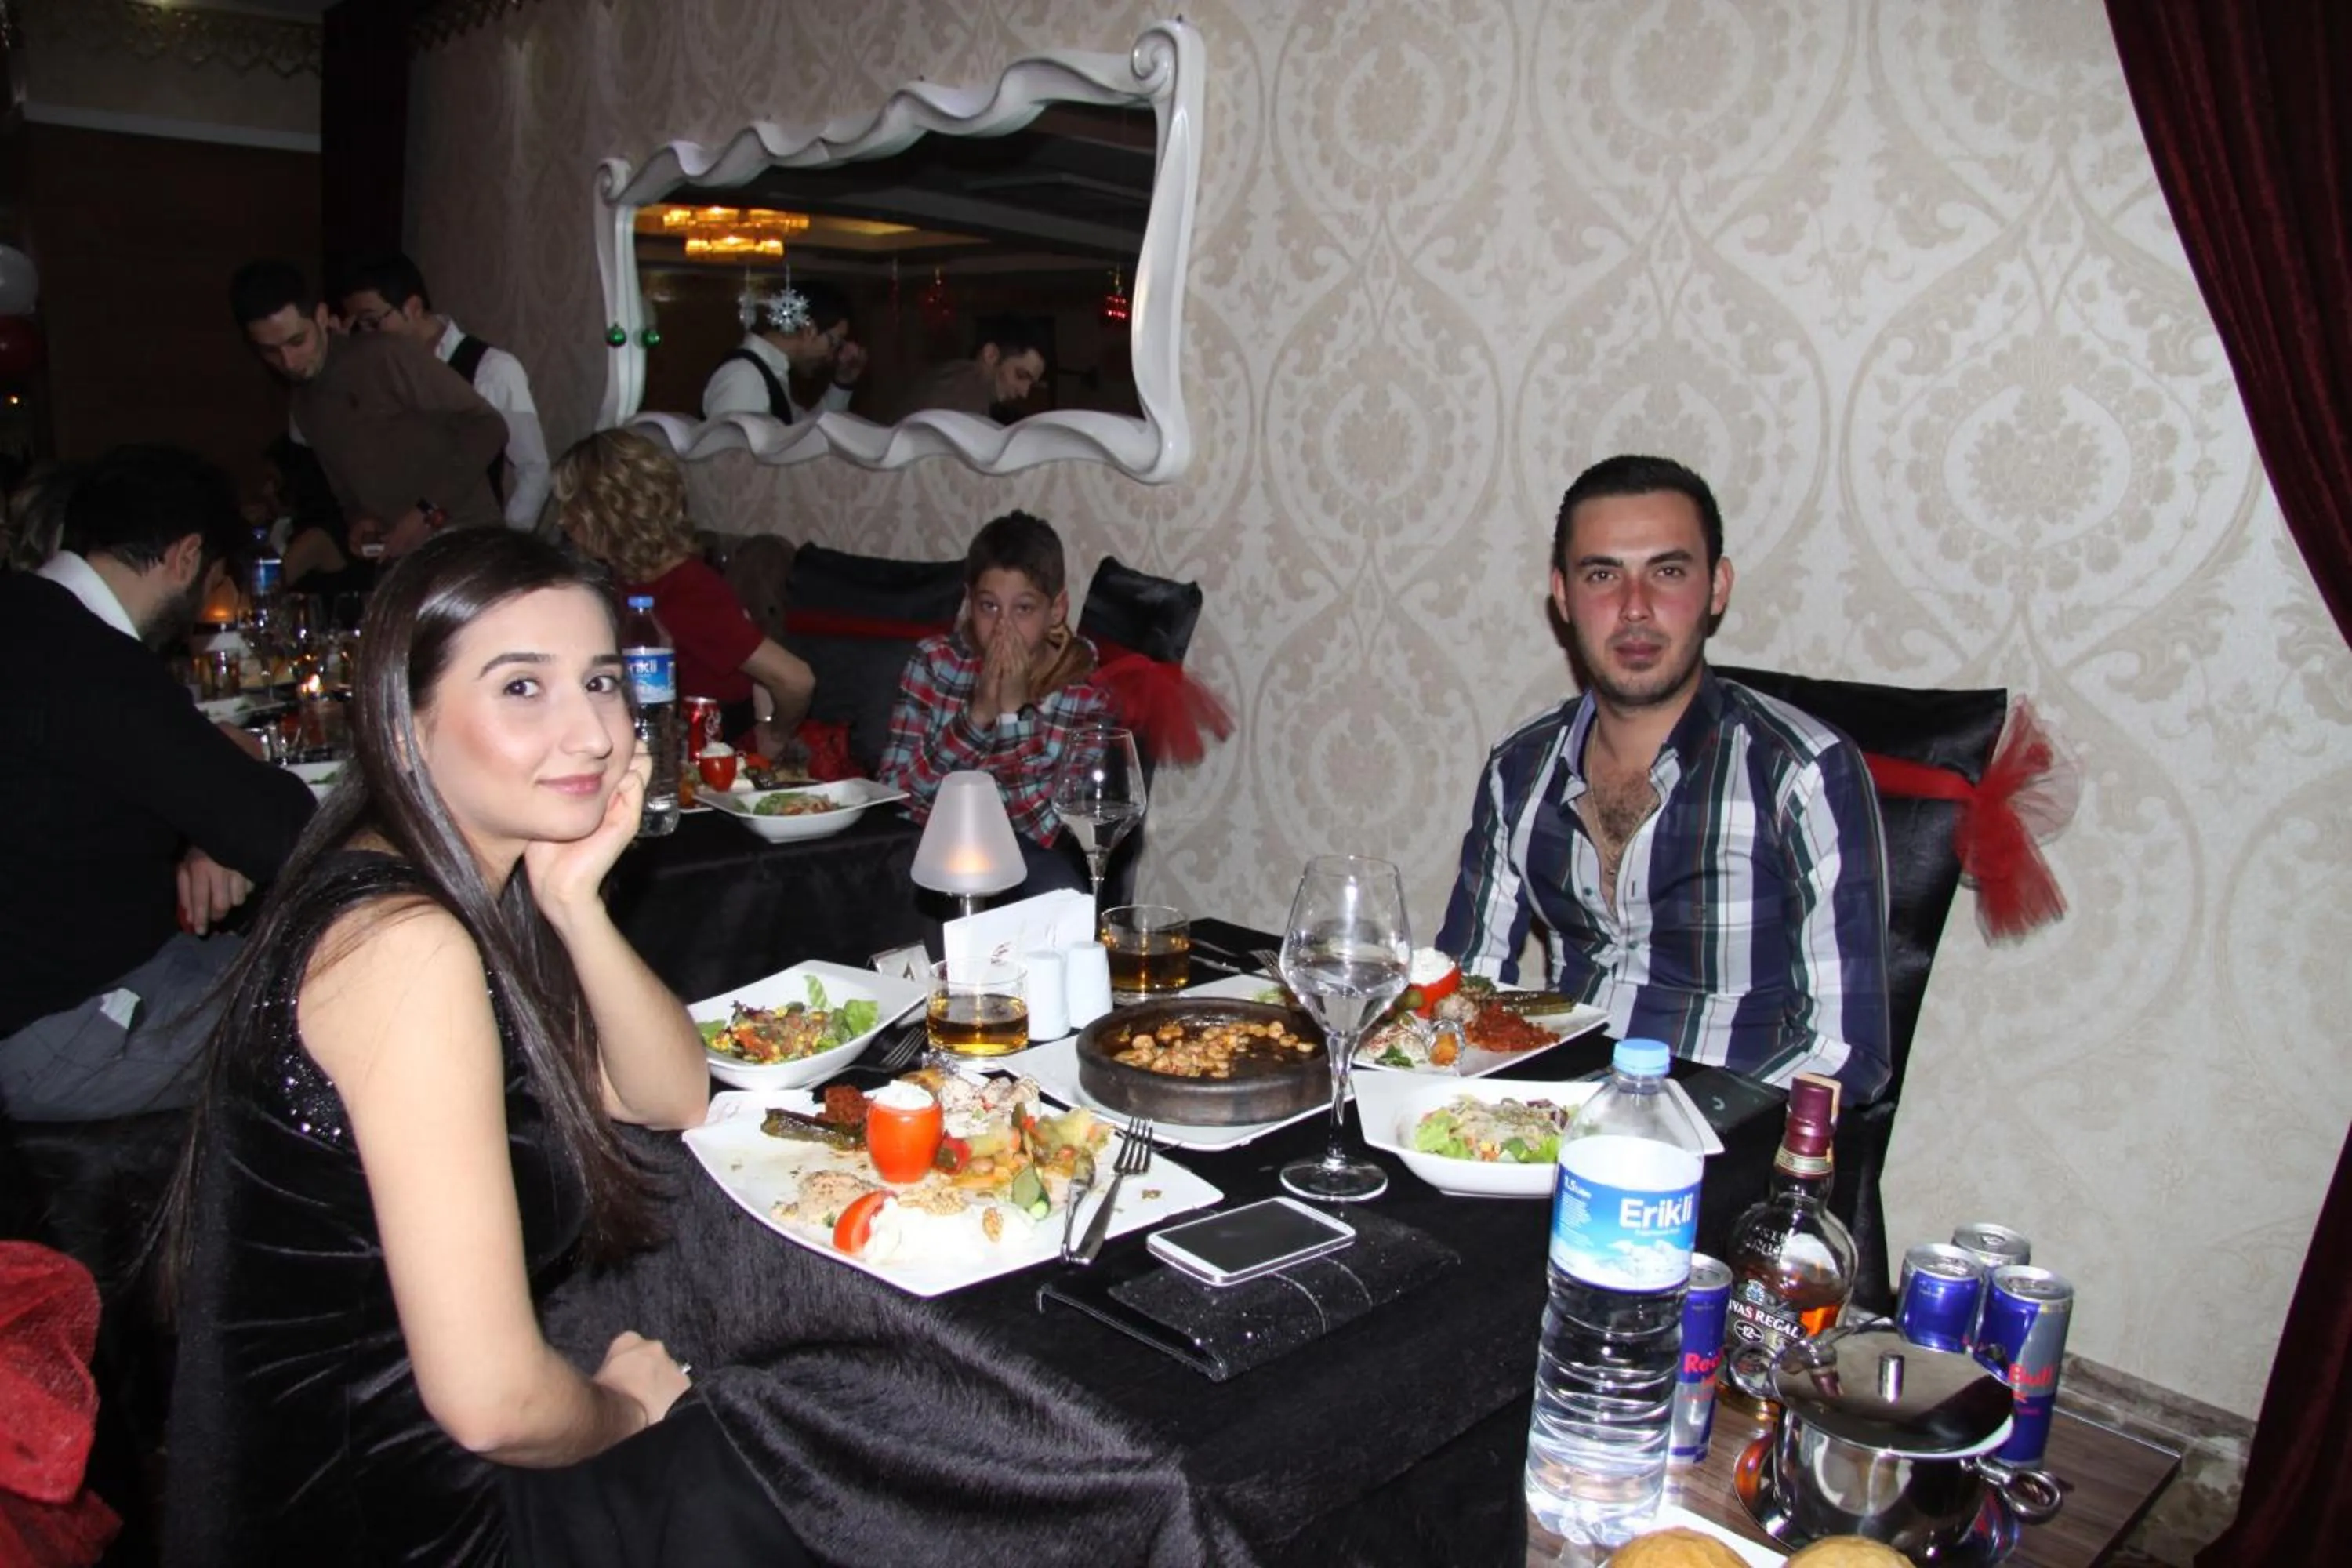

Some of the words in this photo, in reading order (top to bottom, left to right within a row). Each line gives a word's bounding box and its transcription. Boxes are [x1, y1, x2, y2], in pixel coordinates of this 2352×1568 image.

[1619, 1193, 1693, 1229] Erikli
[1728, 1298, 1754, 1319] IVAS
[1755, 1310, 1799, 1338] REGAL
